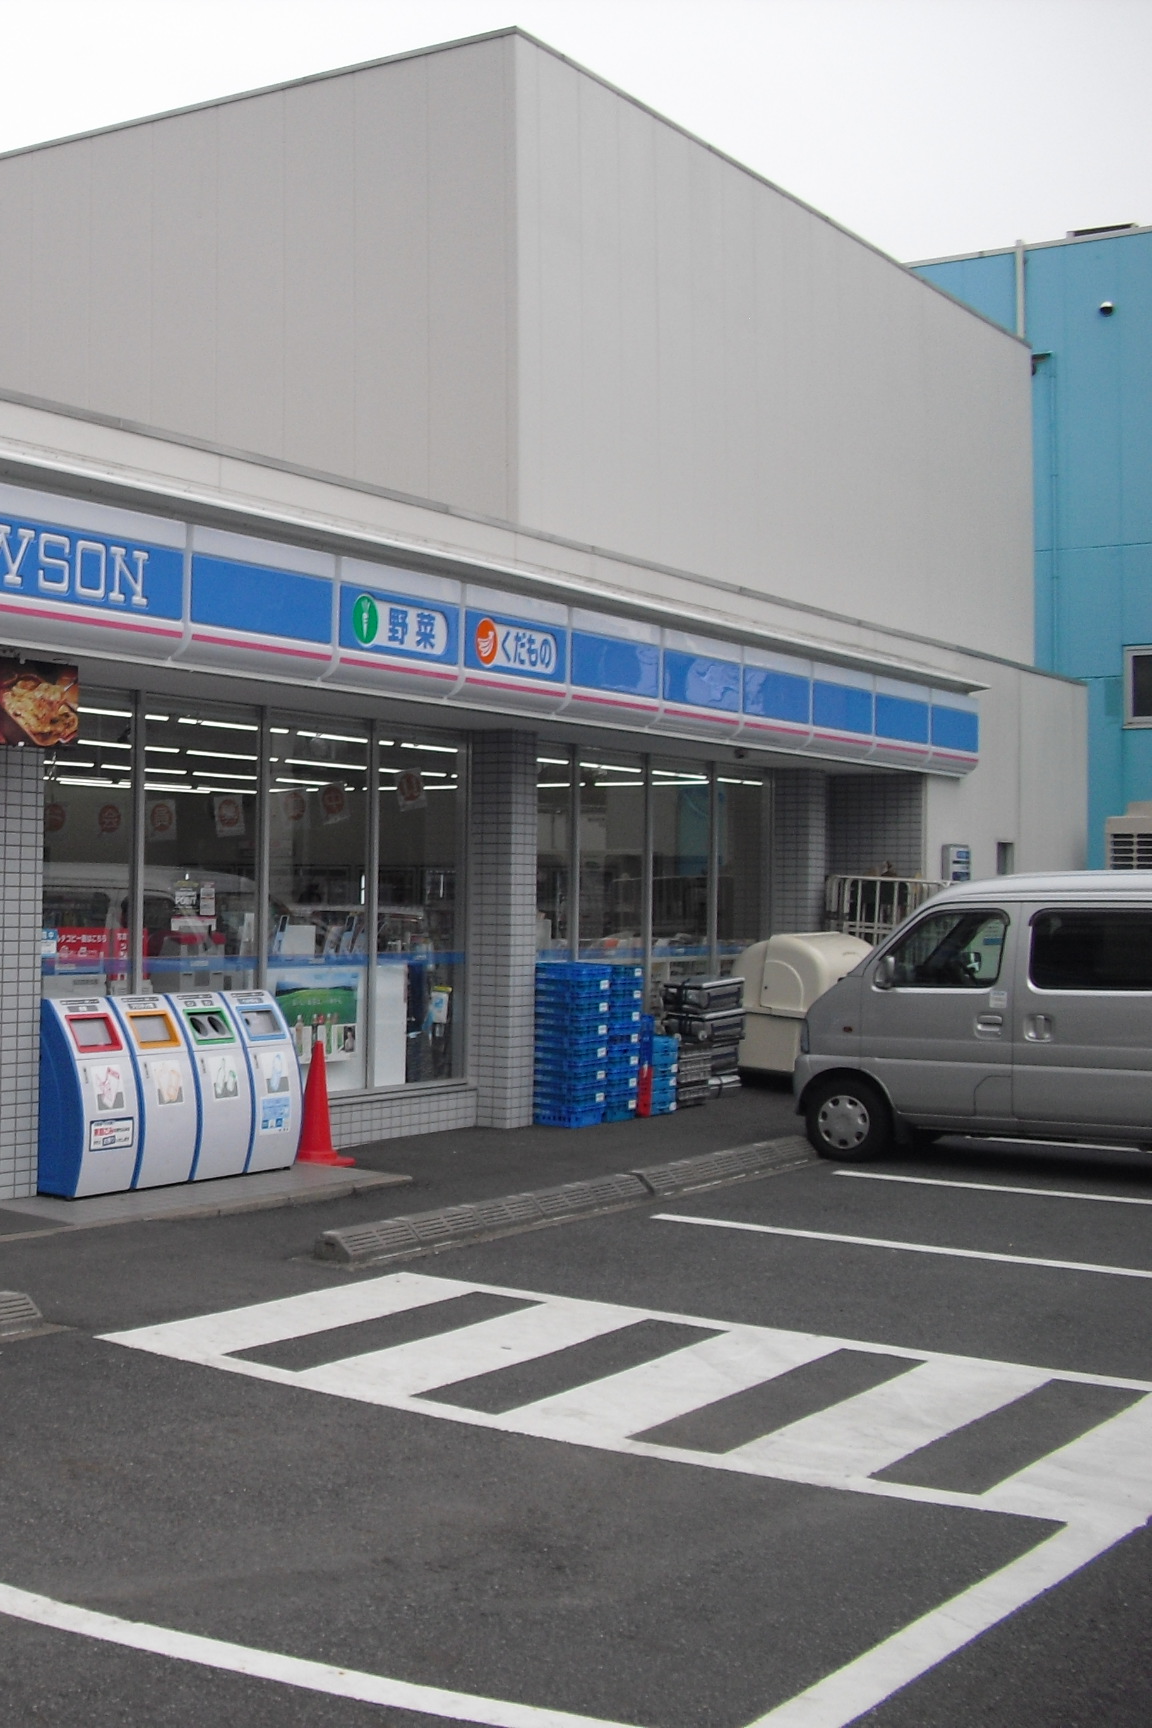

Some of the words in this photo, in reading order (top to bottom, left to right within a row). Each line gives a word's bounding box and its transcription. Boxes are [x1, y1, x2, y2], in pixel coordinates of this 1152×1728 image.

[388, 606, 436, 649] 野菜
[501, 630, 552, 669] くだもの
